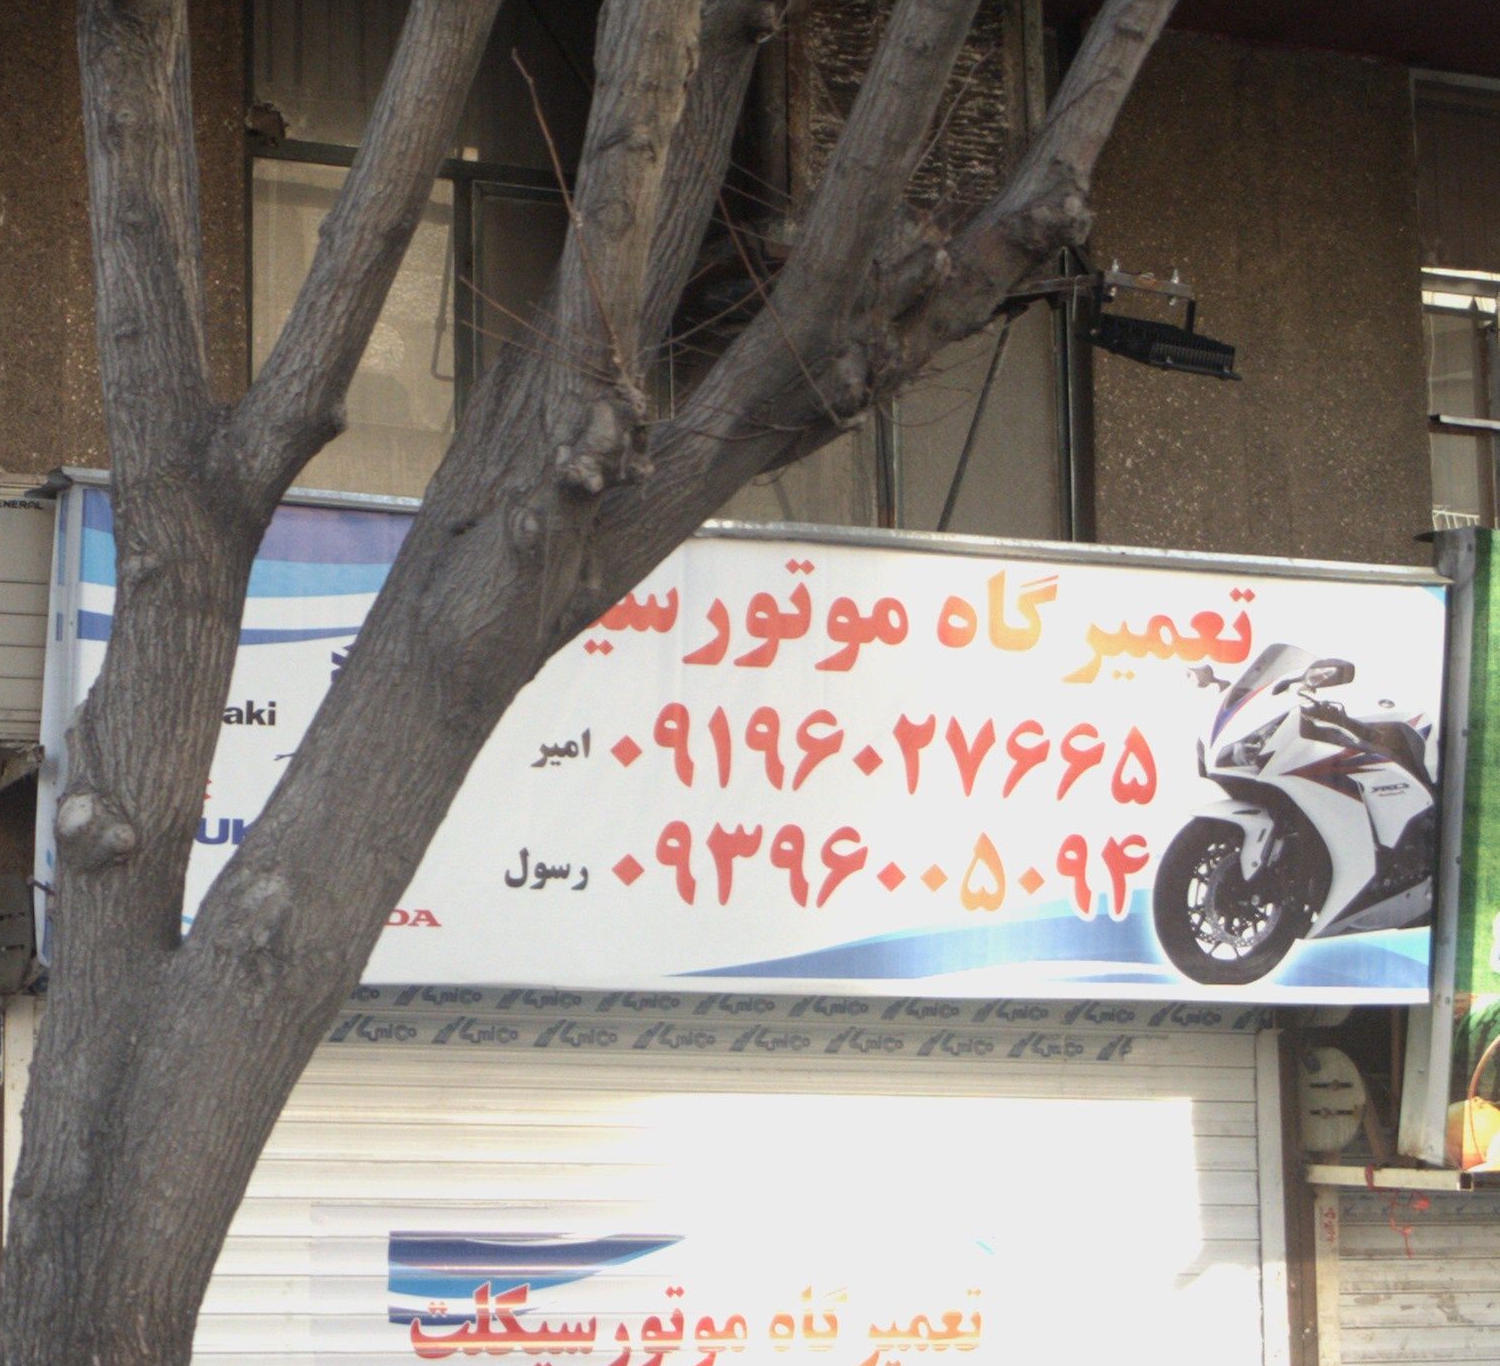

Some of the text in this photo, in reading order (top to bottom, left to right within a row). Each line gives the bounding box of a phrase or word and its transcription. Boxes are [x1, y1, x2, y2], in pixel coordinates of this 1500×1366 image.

[937, 569, 1059, 651] گاه
[1062, 586, 1255, 684] تعمیر
[530, 702, 1158, 806] ۰۹۱۹۶۰۲۷۶۶۵ امیر
[504, 820, 1151, 915] ۰۹۳۹۶۰۰۵۰۹۴ رسول
